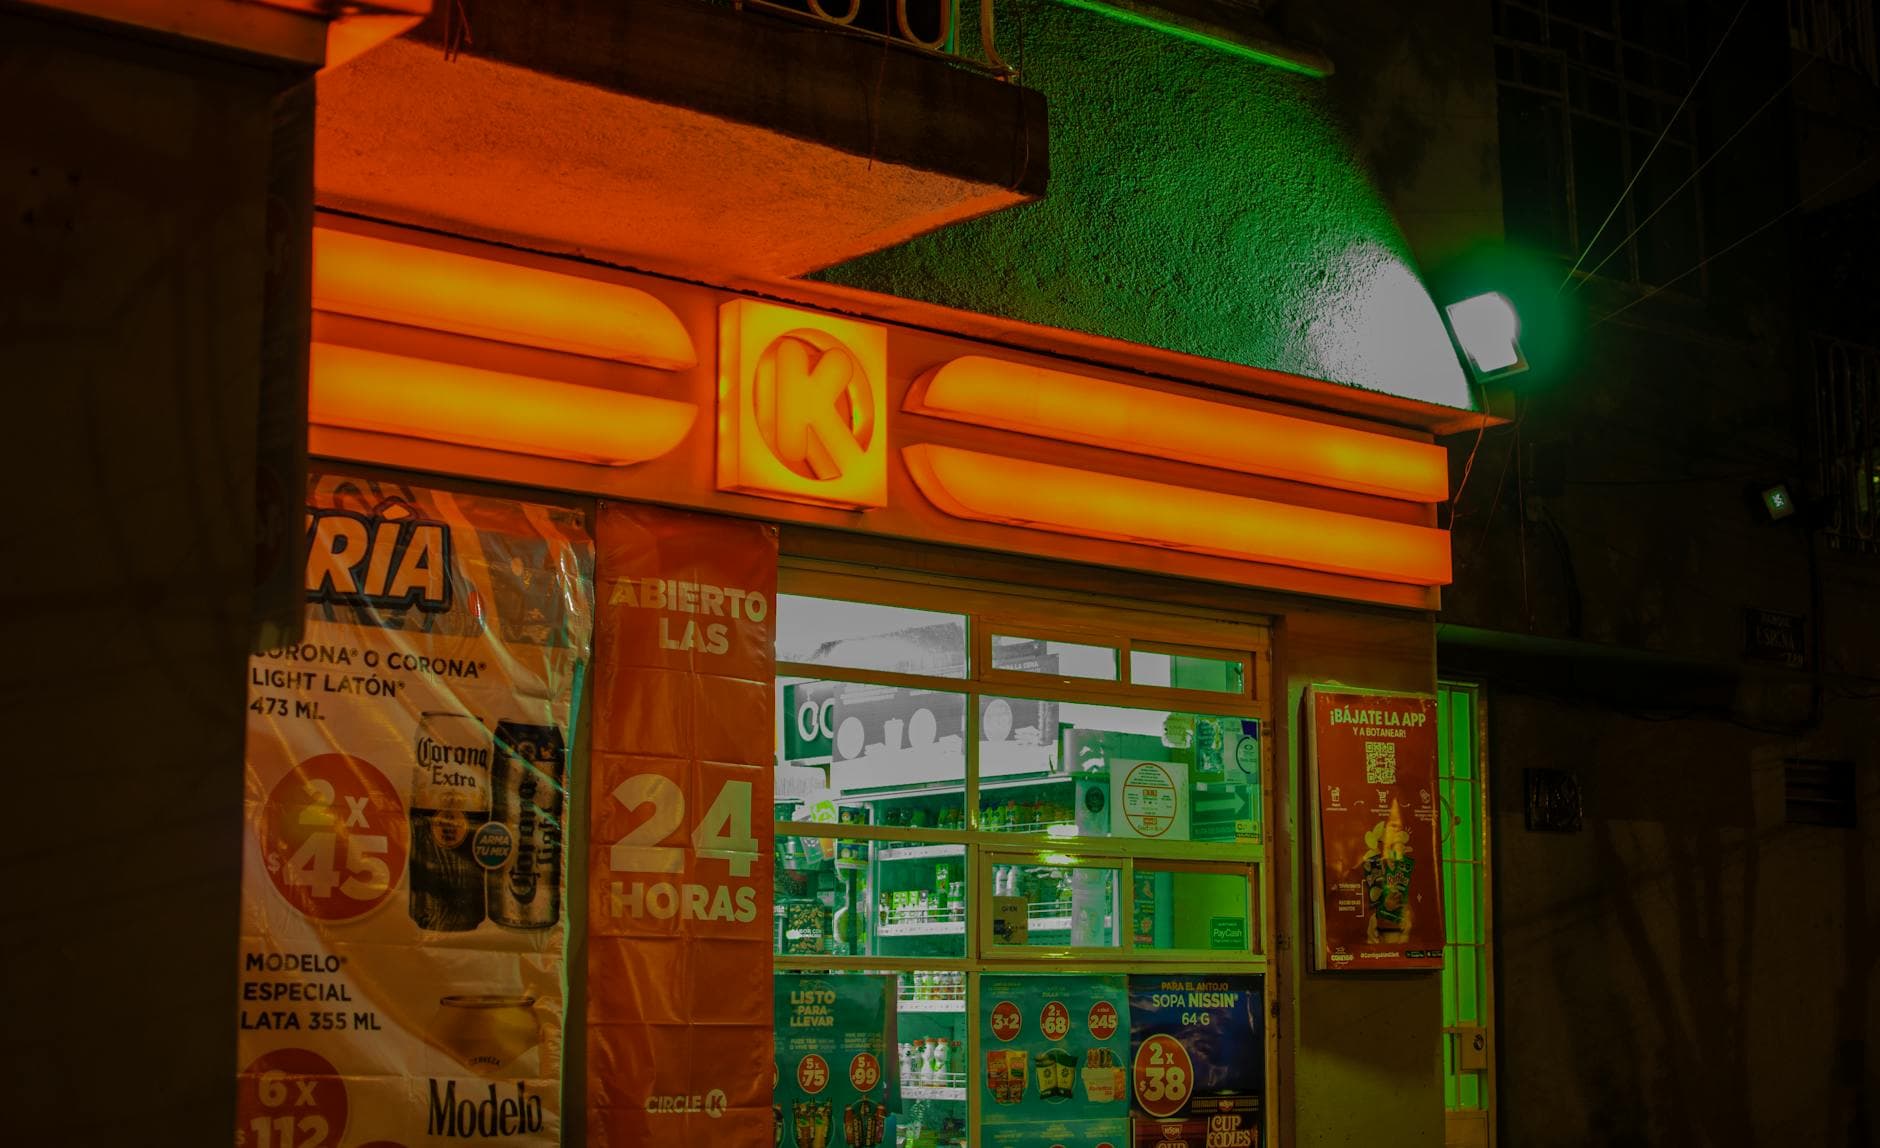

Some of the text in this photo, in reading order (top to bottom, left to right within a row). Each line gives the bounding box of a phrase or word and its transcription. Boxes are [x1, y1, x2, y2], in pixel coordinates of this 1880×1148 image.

[305, 500, 452, 611] RÍA
[608, 575, 767, 623] ABIERTO
[659, 617, 729, 654] LAS
[364, 650, 379, 668] O
[252, 668, 317, 691] LIGHT
[250, 697, 289, 717] 473
[1330, 704, 1426, 727] ¡BÁJATE LA APP
[1352, 726, 1359, 736] Y
[1360, 728, 1365, 736] A
[417, 736, 488, 771] Corona
[432, 765, 476, 788] Extra
[610, 774, 759, 878] 24
[479, 834, 509, 846] ARMA
[476, 846, 509, 857] TU MIX
[611, 881, 757, 924] HORAS
[243, 982, 352, 1002] ESPECIAL
[1161, 981, 1229, 992] PARA EL ANTOJO
[790, 990, 836, 1005] LISTO
[1152, 994, 1185, 1008] SOPA
[241, 1011, 381, 1030] LATA 355 ML
[798, 1005, 828, 1016] PARA
[1181, 1012, 1210, 1026] 64 G
[790, 1016, 834, 1028] LLEVAR
[427, 1077, 544, 1138] Modelo
[645, 1089, 727, 1118] CIRCLE K
[1211, 1114, 1243, 1132] CUP
